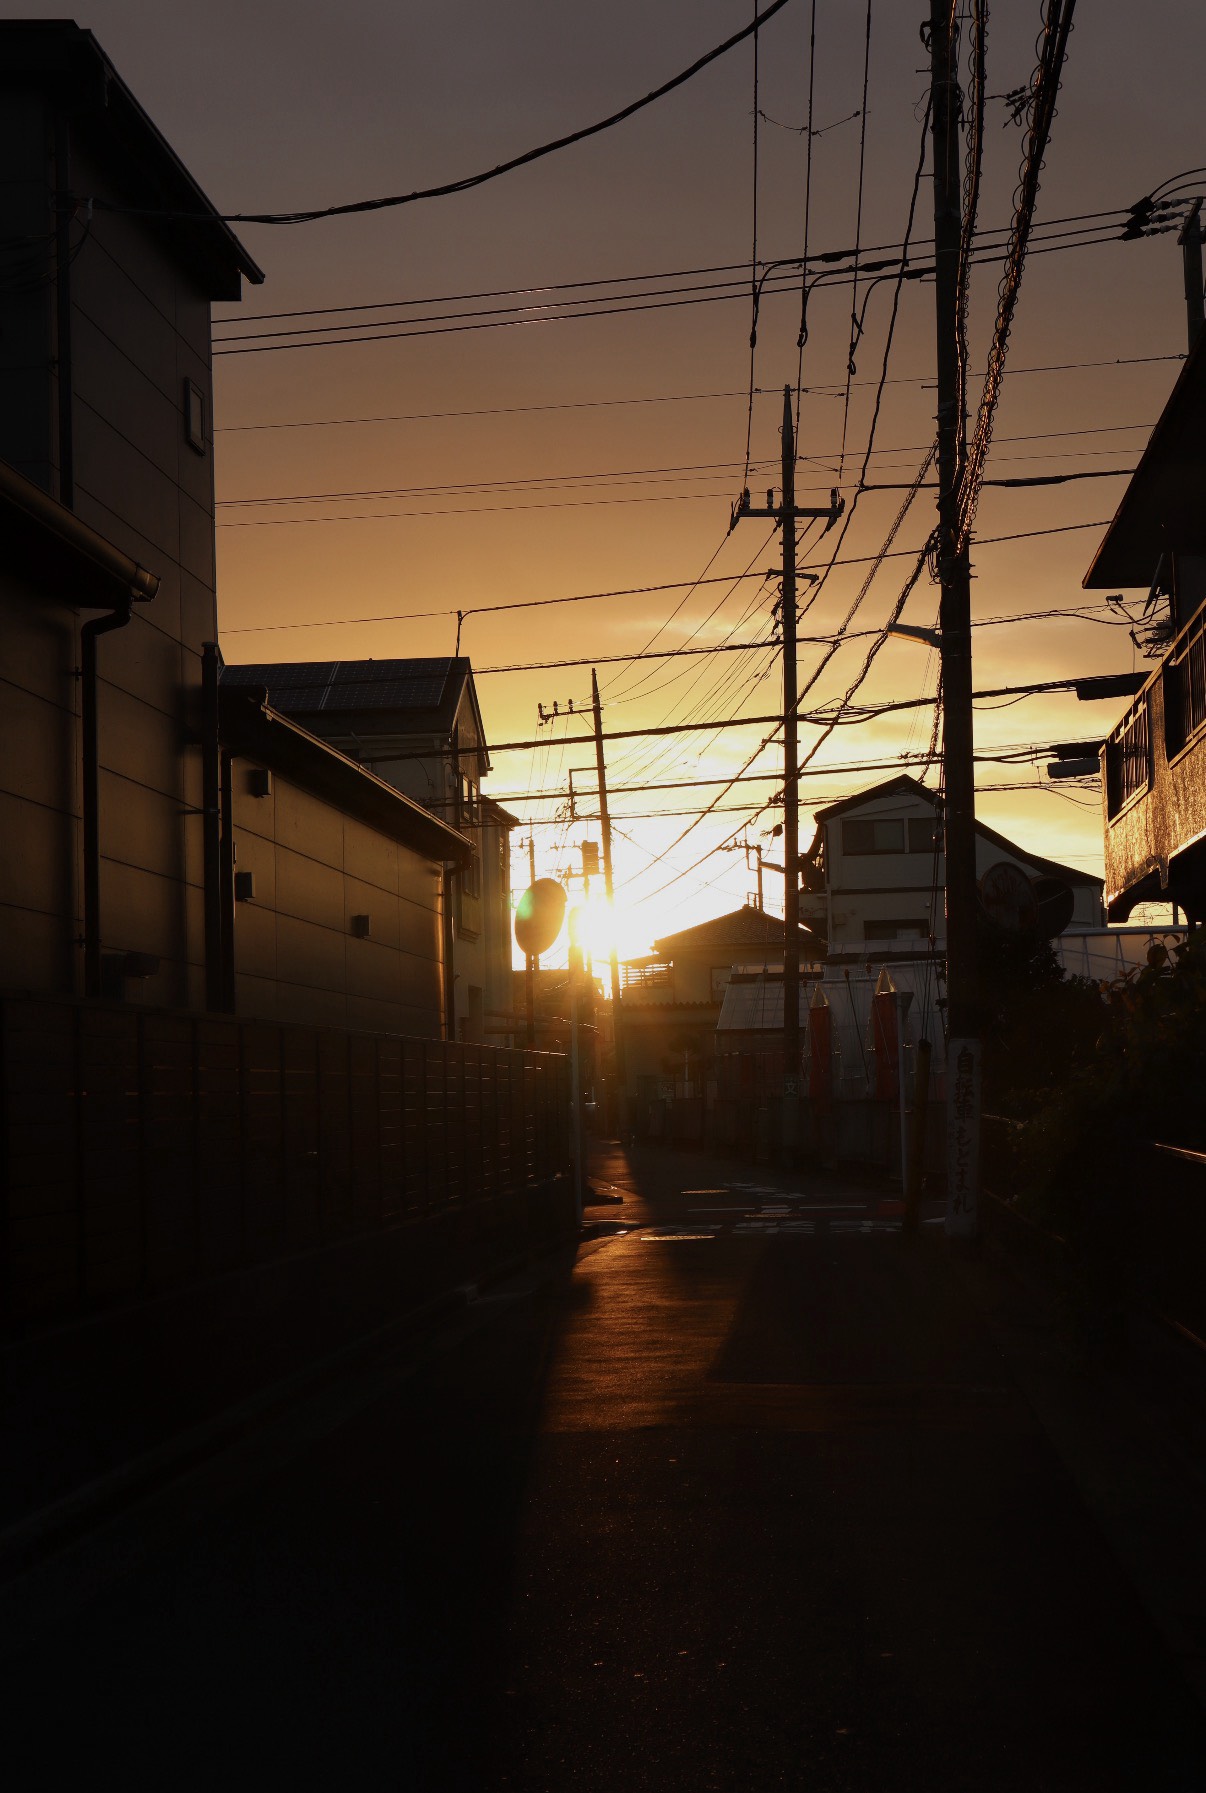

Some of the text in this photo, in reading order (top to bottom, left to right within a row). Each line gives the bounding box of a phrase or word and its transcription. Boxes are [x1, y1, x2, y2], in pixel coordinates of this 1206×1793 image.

[784, 1082, 797, 1095] 文
[953, 1047, 975, 1215] 自転車もとまれ
